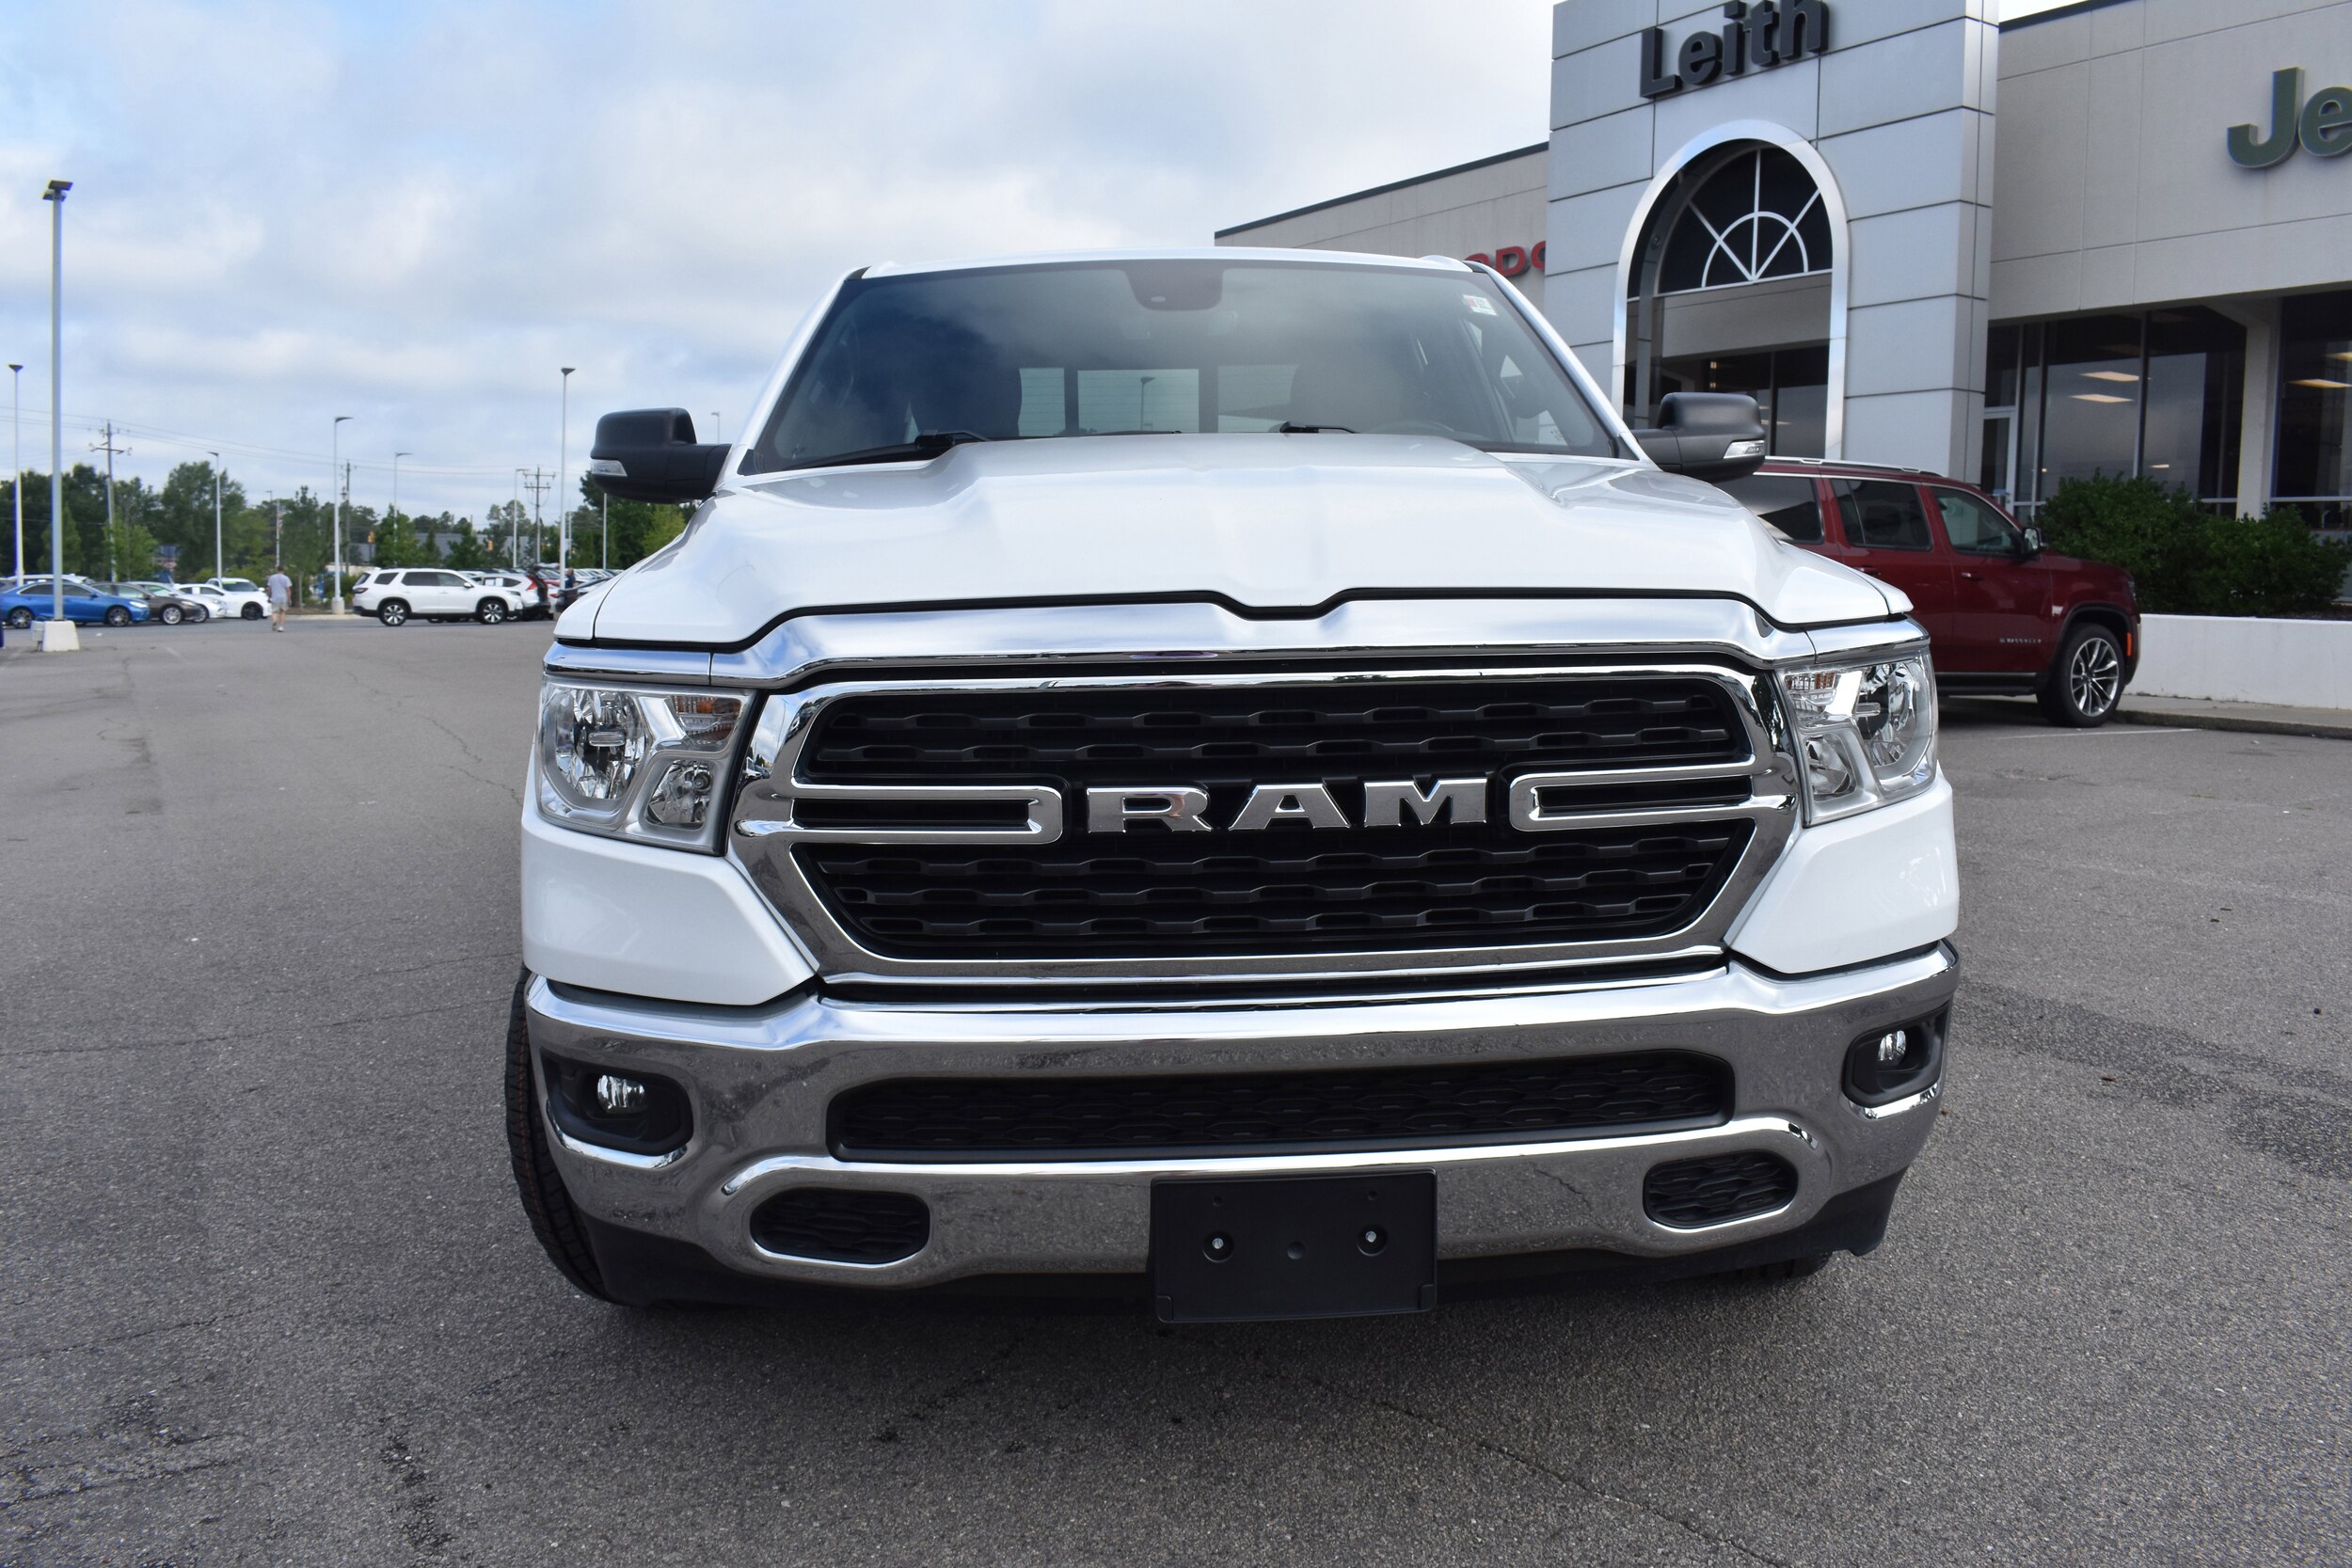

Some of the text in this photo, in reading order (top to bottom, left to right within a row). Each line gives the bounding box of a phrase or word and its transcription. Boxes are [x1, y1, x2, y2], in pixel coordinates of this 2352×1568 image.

[1639, 0, 1830, 99] Leith
[2228, 67, 2352, 169] Je
[1086, 776, 1488, 833] RAM
